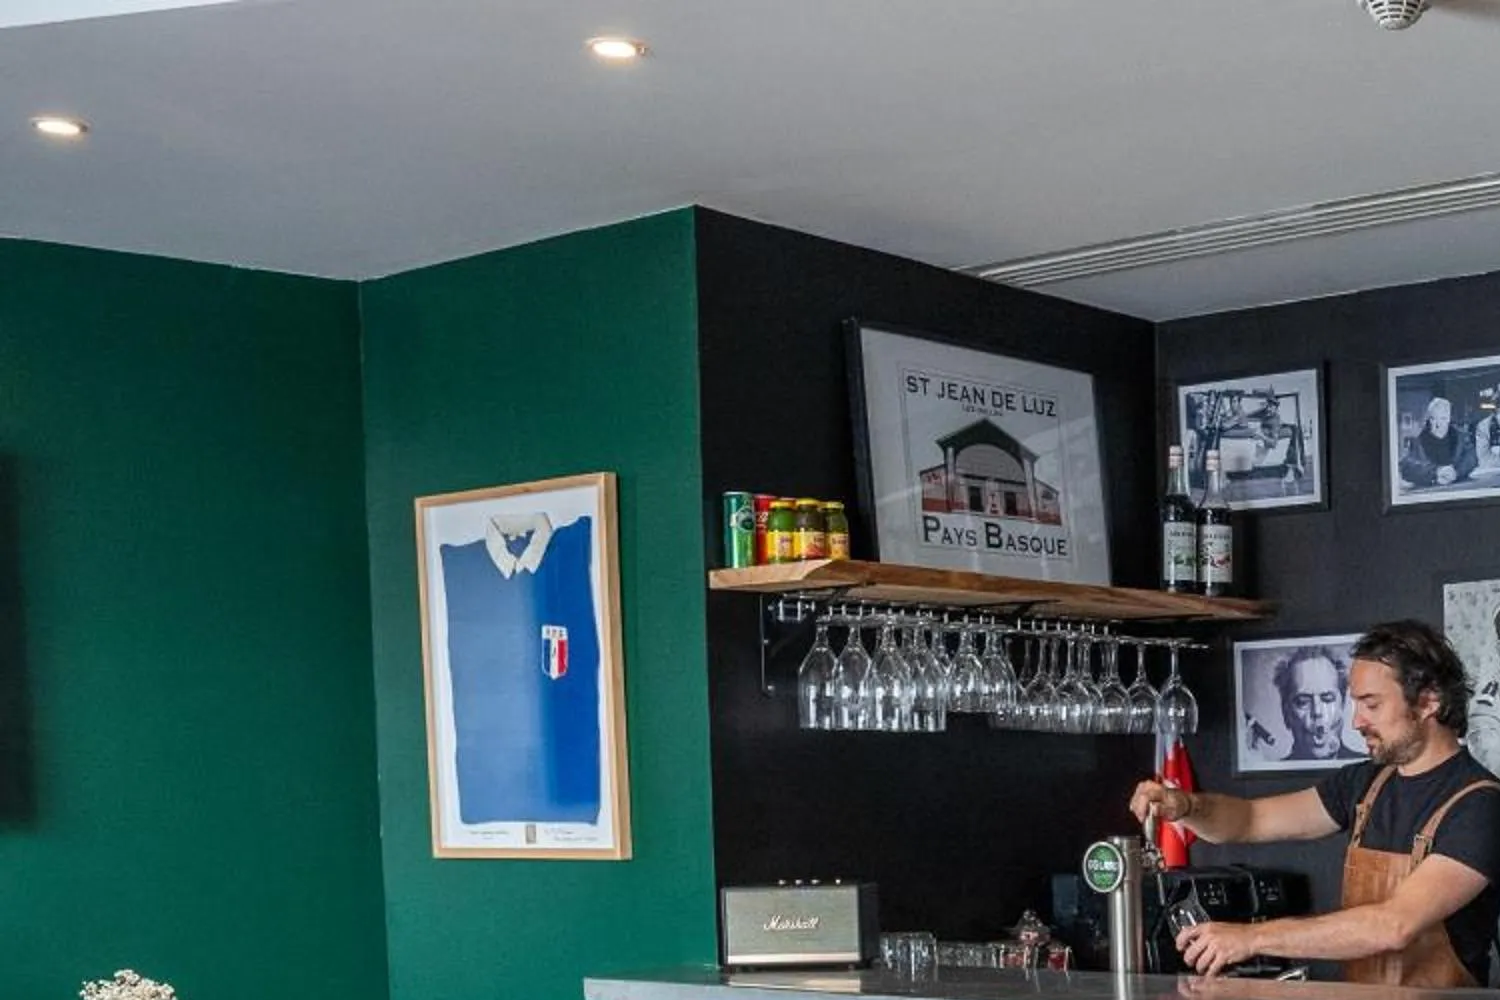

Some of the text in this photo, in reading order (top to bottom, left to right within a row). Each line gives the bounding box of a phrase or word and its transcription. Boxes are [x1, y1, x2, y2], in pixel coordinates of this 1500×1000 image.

[906, 375, 930, 396] ST
[937, 381, 985, 406] JEAN
[991, 391, 1017, 411] DE
[1022, 395, 1057, 417] LUZ
[763, 915, 820, 930] Marshall
